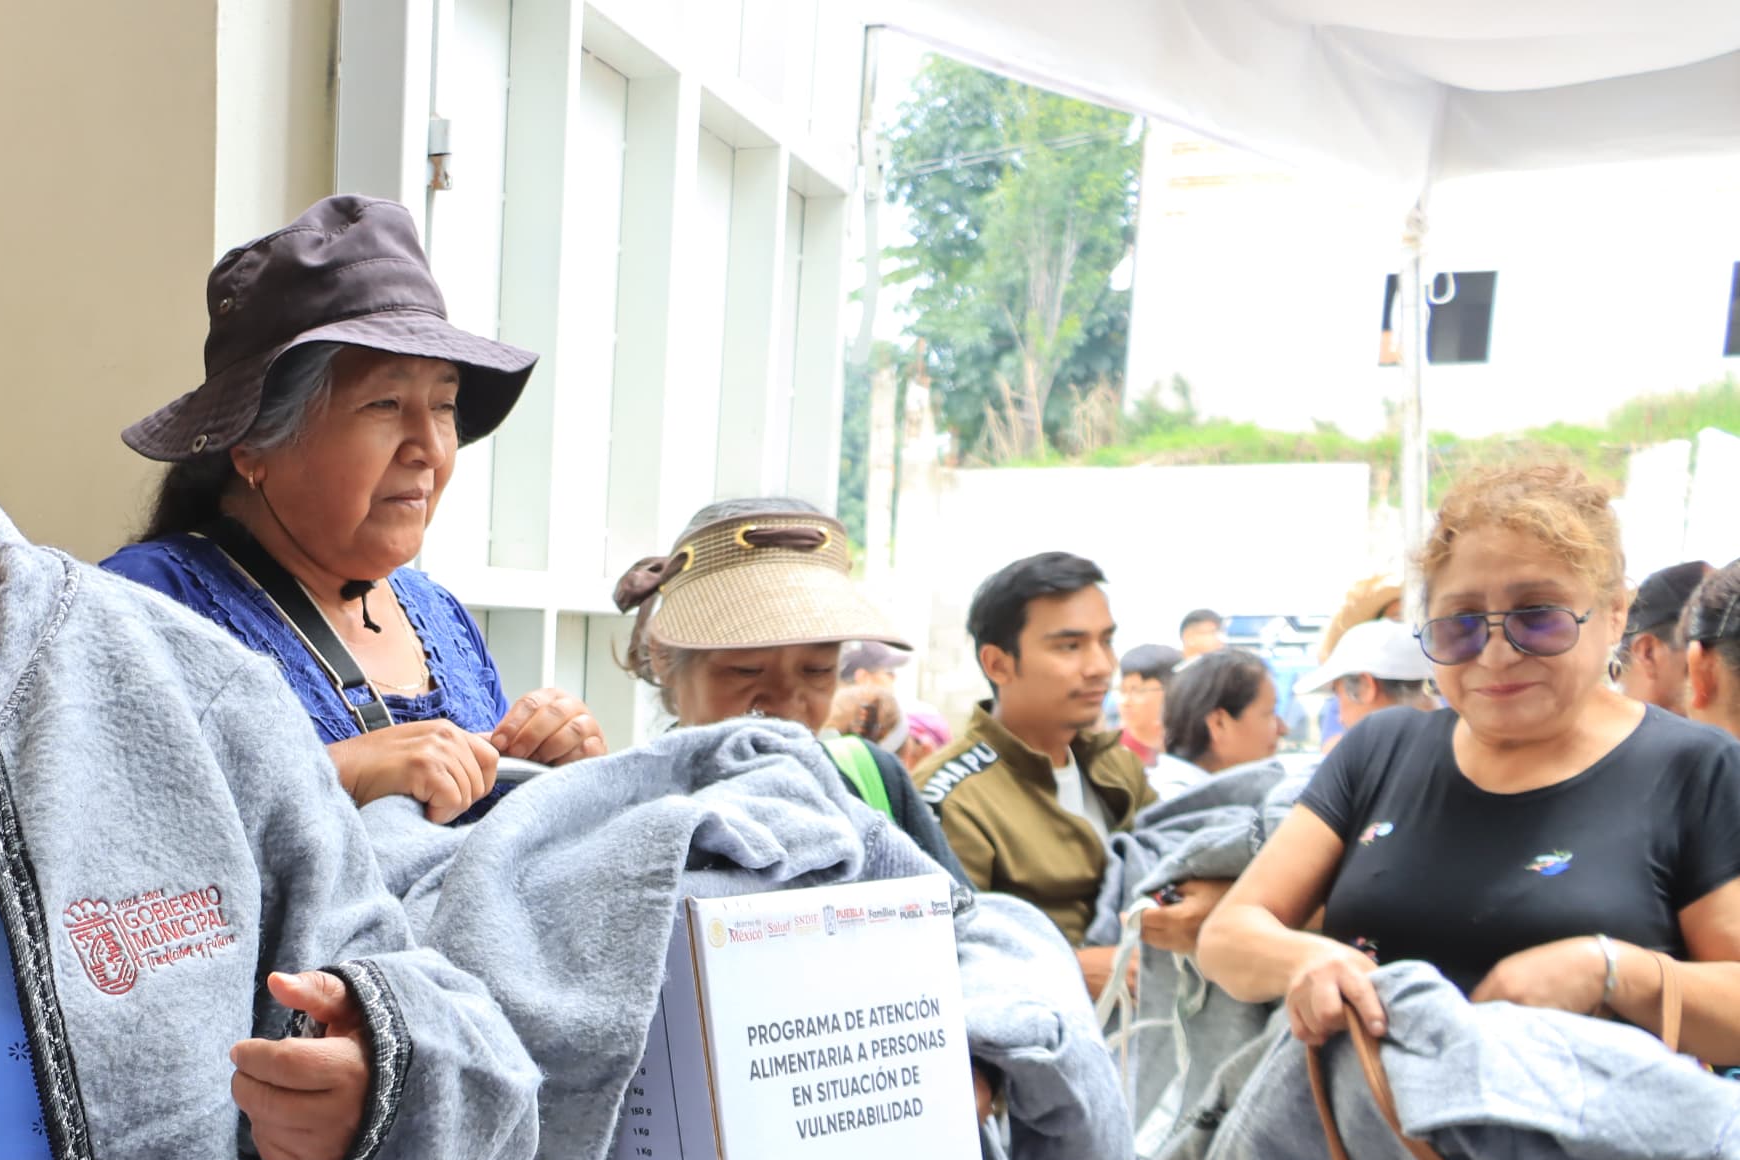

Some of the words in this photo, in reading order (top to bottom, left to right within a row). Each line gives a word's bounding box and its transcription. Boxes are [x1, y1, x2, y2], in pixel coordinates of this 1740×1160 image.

[123, 883, 221, 929] GOBIERNO
[131, 908, 229, 952] MUNICIPAL
[747, 1013, 842, 1047] PROGRAMA
[844, 1009, 865, 1031] DE
[869, 998, 940, 1027] ATENCIÓN
[749, 1044, 854, 1081] ALIMENTARIA
[857, 1042, 869, 1062] A
[871, 1028, 946, 1059] PERSONAS
[792, 1084, 813, 1107] EN
[816, 1069, 898, 1103] SITUACIÓN
[900, 1065, 920, 1087] DE
[795, 1097, 923, 1140] VULNERABILIDAD
